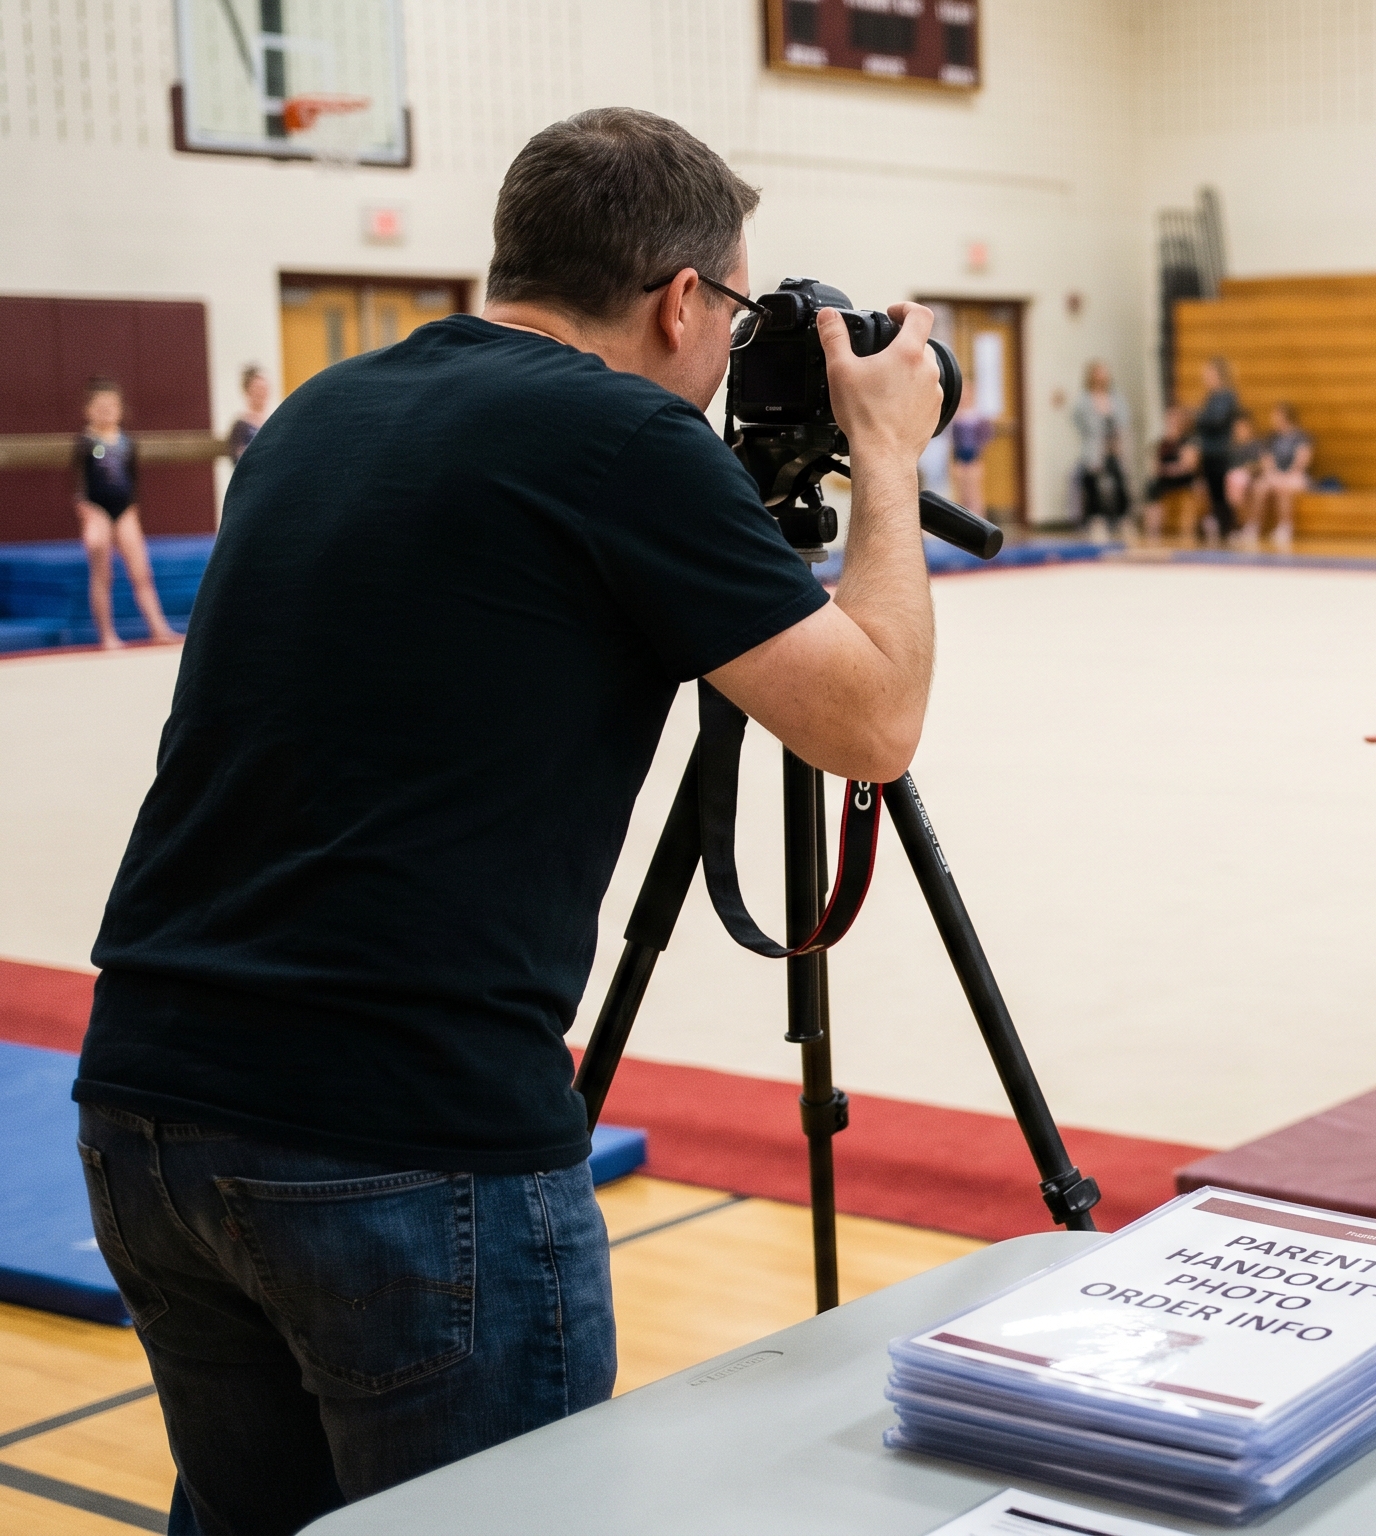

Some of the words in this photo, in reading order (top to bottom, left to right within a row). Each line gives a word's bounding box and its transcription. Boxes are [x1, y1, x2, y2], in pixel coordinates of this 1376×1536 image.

[1080, 1282, 1223, 1321] ORDER
[1226, 1312, 1333, 1341] INFO
[1164, 1273, 1312, 1310] PHOTO
